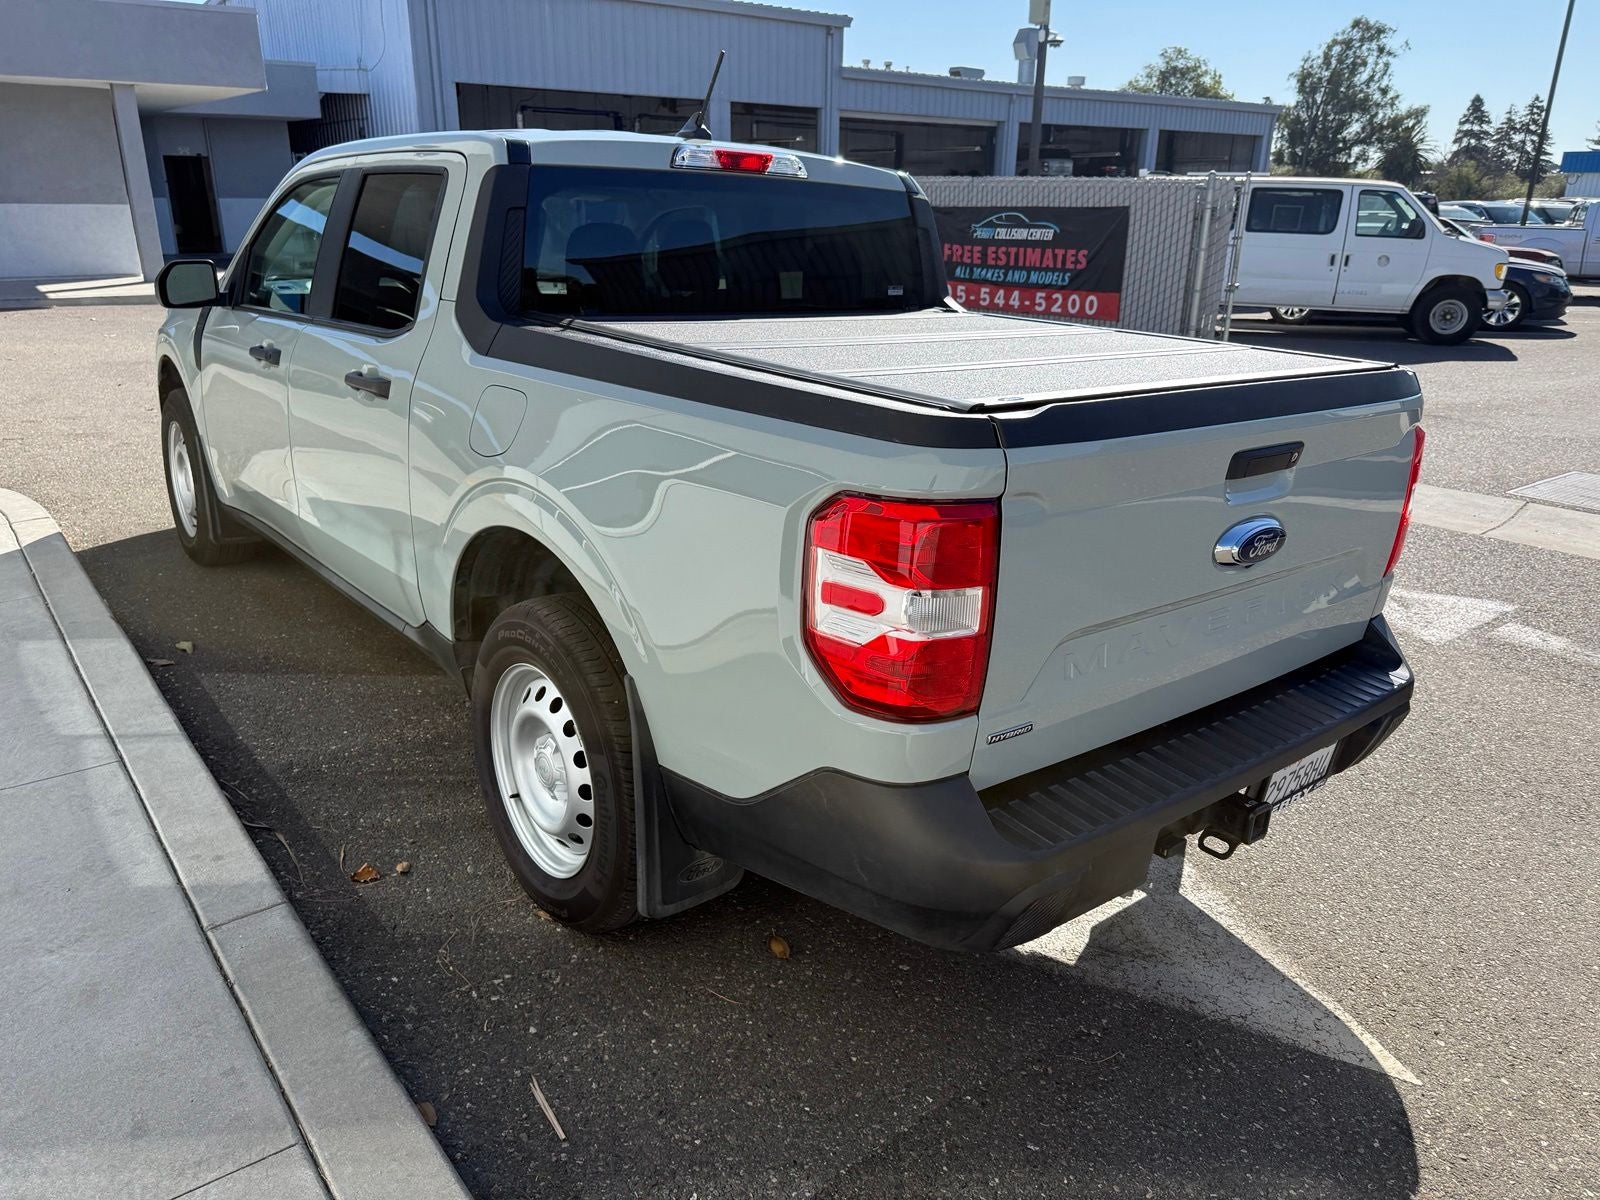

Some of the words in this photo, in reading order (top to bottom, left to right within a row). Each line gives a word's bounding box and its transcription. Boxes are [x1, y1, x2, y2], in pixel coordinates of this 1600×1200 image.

[994, 228, 1027, 240] COLLISION
[1028, 229, 1054, 240] CENTER
[943, 243, 982, 264] FREE
[986, 246, 1089, 270] ESTIMATES
[954, 265, 970, 279] ALL
[972, 267, 1005, 281] MAKES
[1005, 269, 1027, 283] AND
[1029, 271, 1071, 286] MODELS
[1249, 533, 1280, 558] Ford
[991, 726, 1032, 742] HYBRID
